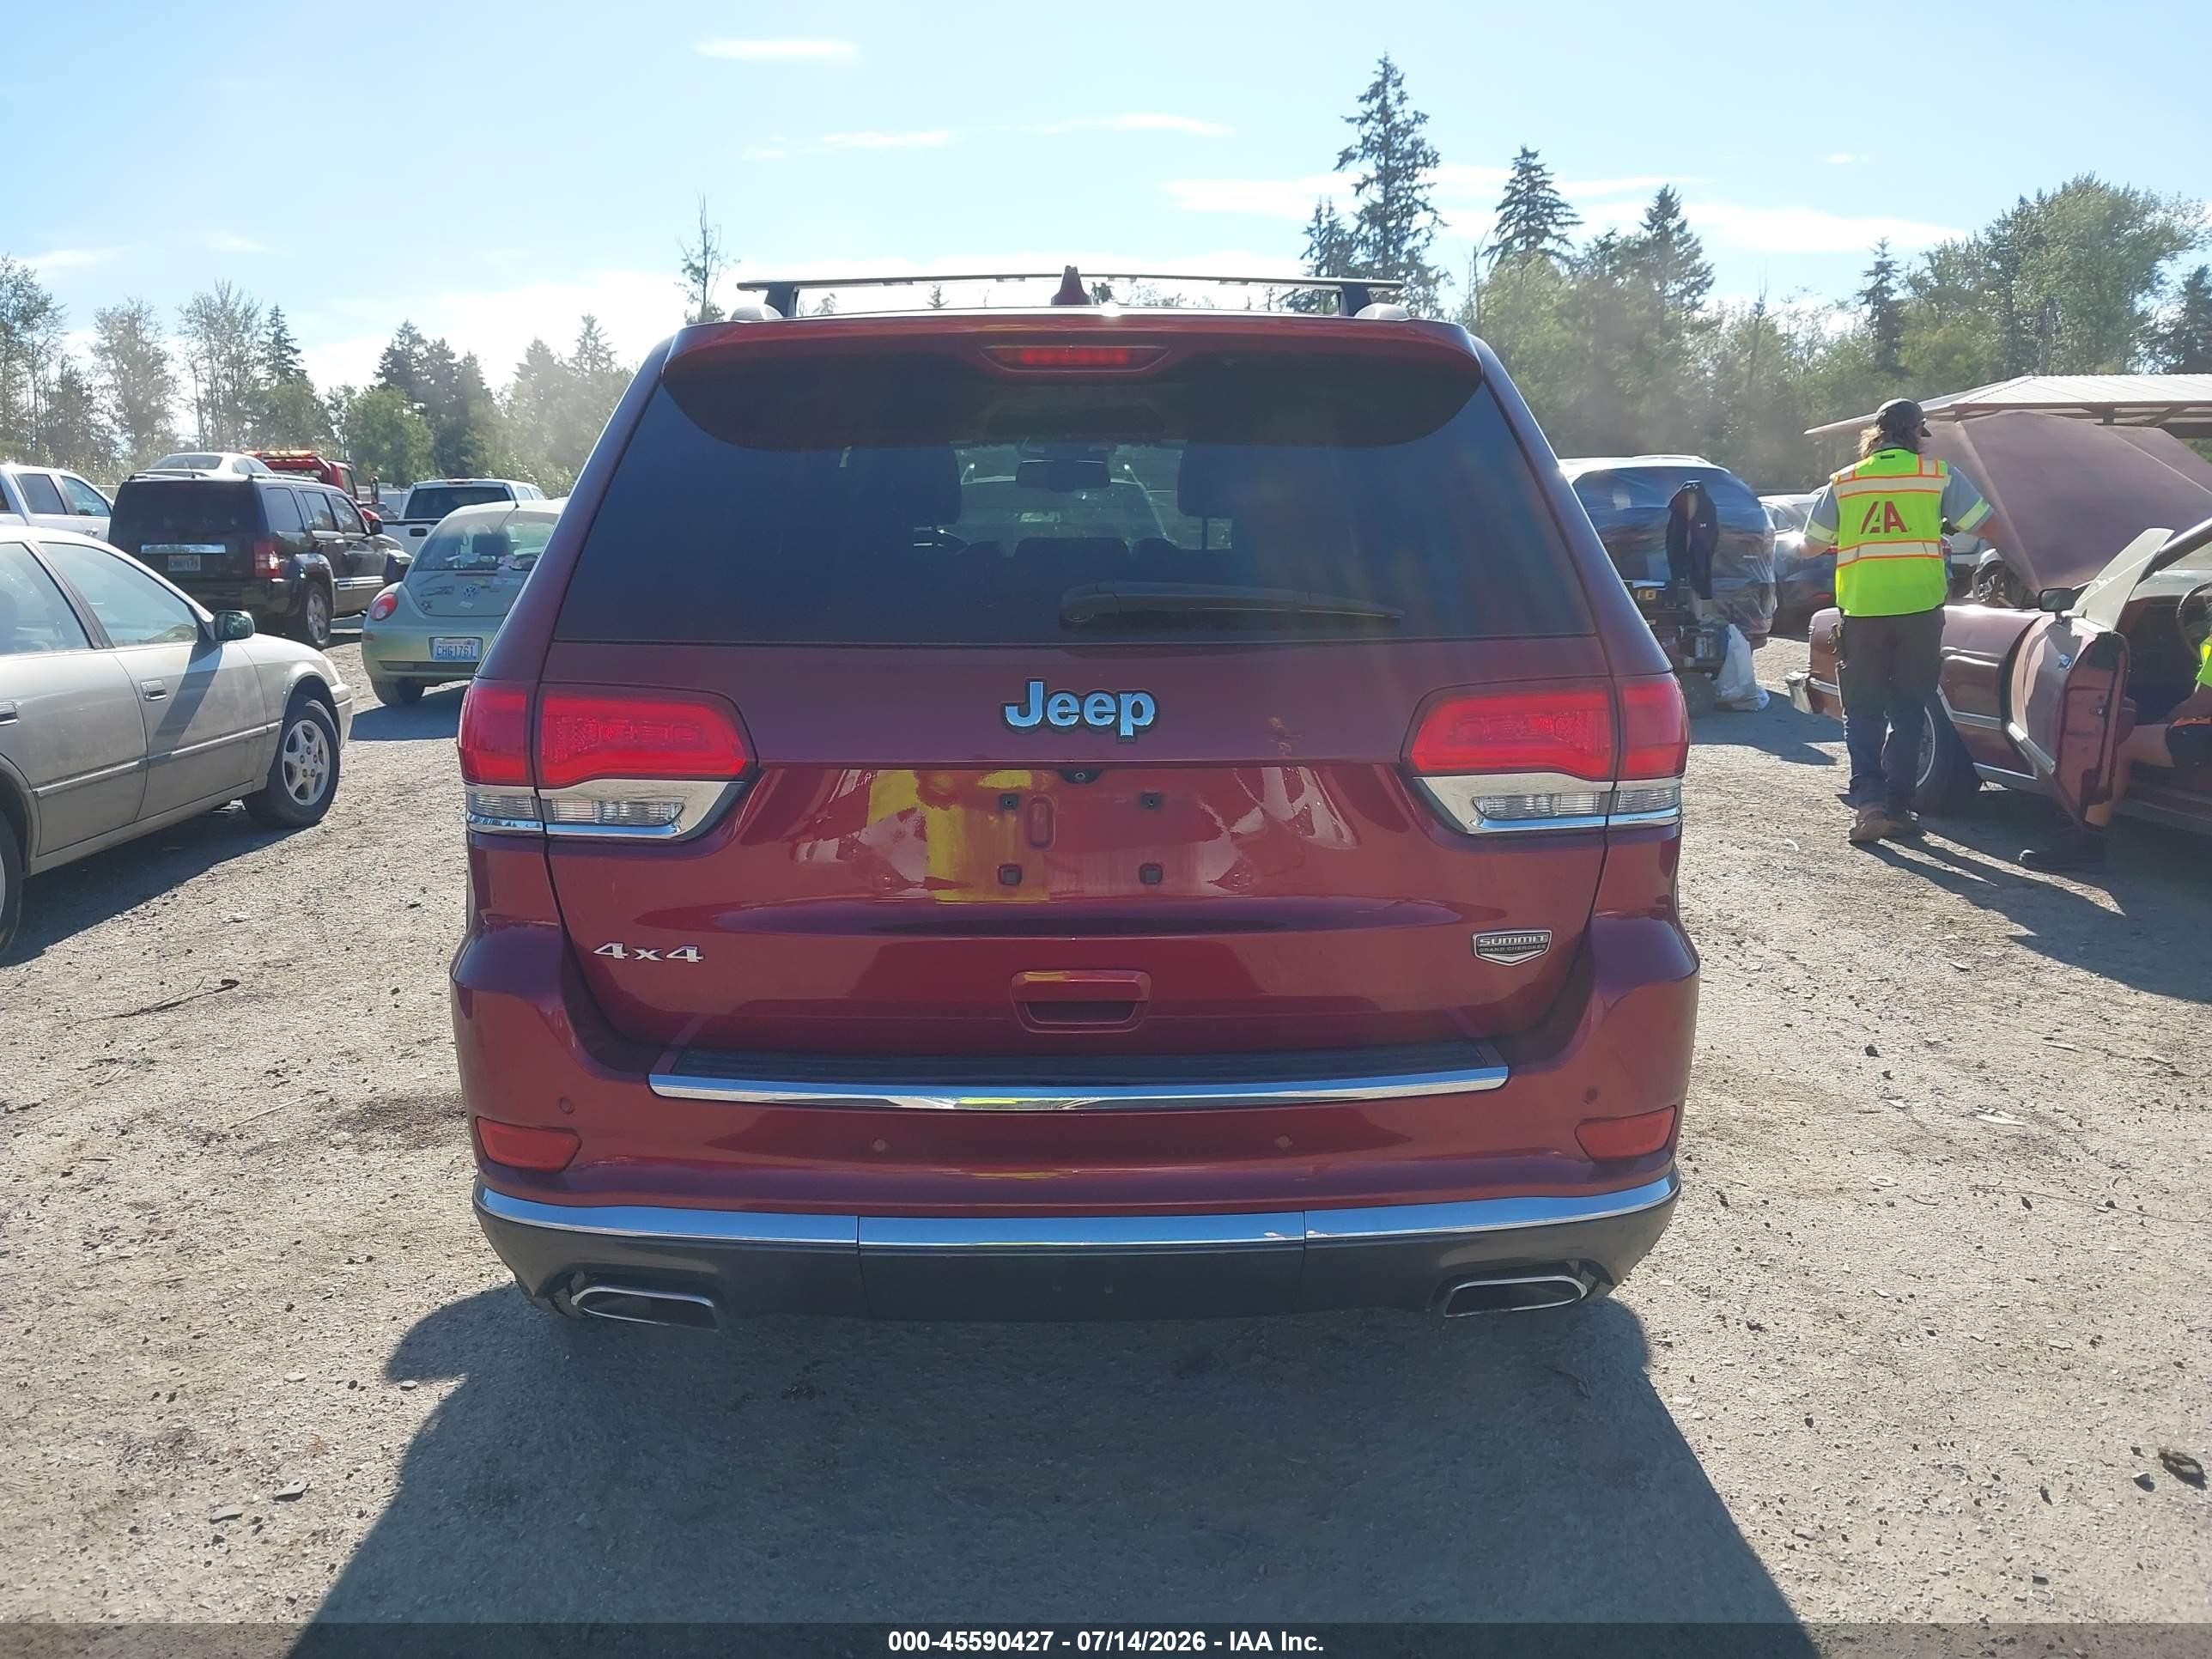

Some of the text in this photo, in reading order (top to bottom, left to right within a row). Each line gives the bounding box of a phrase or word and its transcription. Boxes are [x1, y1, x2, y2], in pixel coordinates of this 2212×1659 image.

[1003, 679, 1158, 738] Jeep
[1479, 935, 1547, 946] SUMMIT
[592, 942, 705, 963] 4x4
